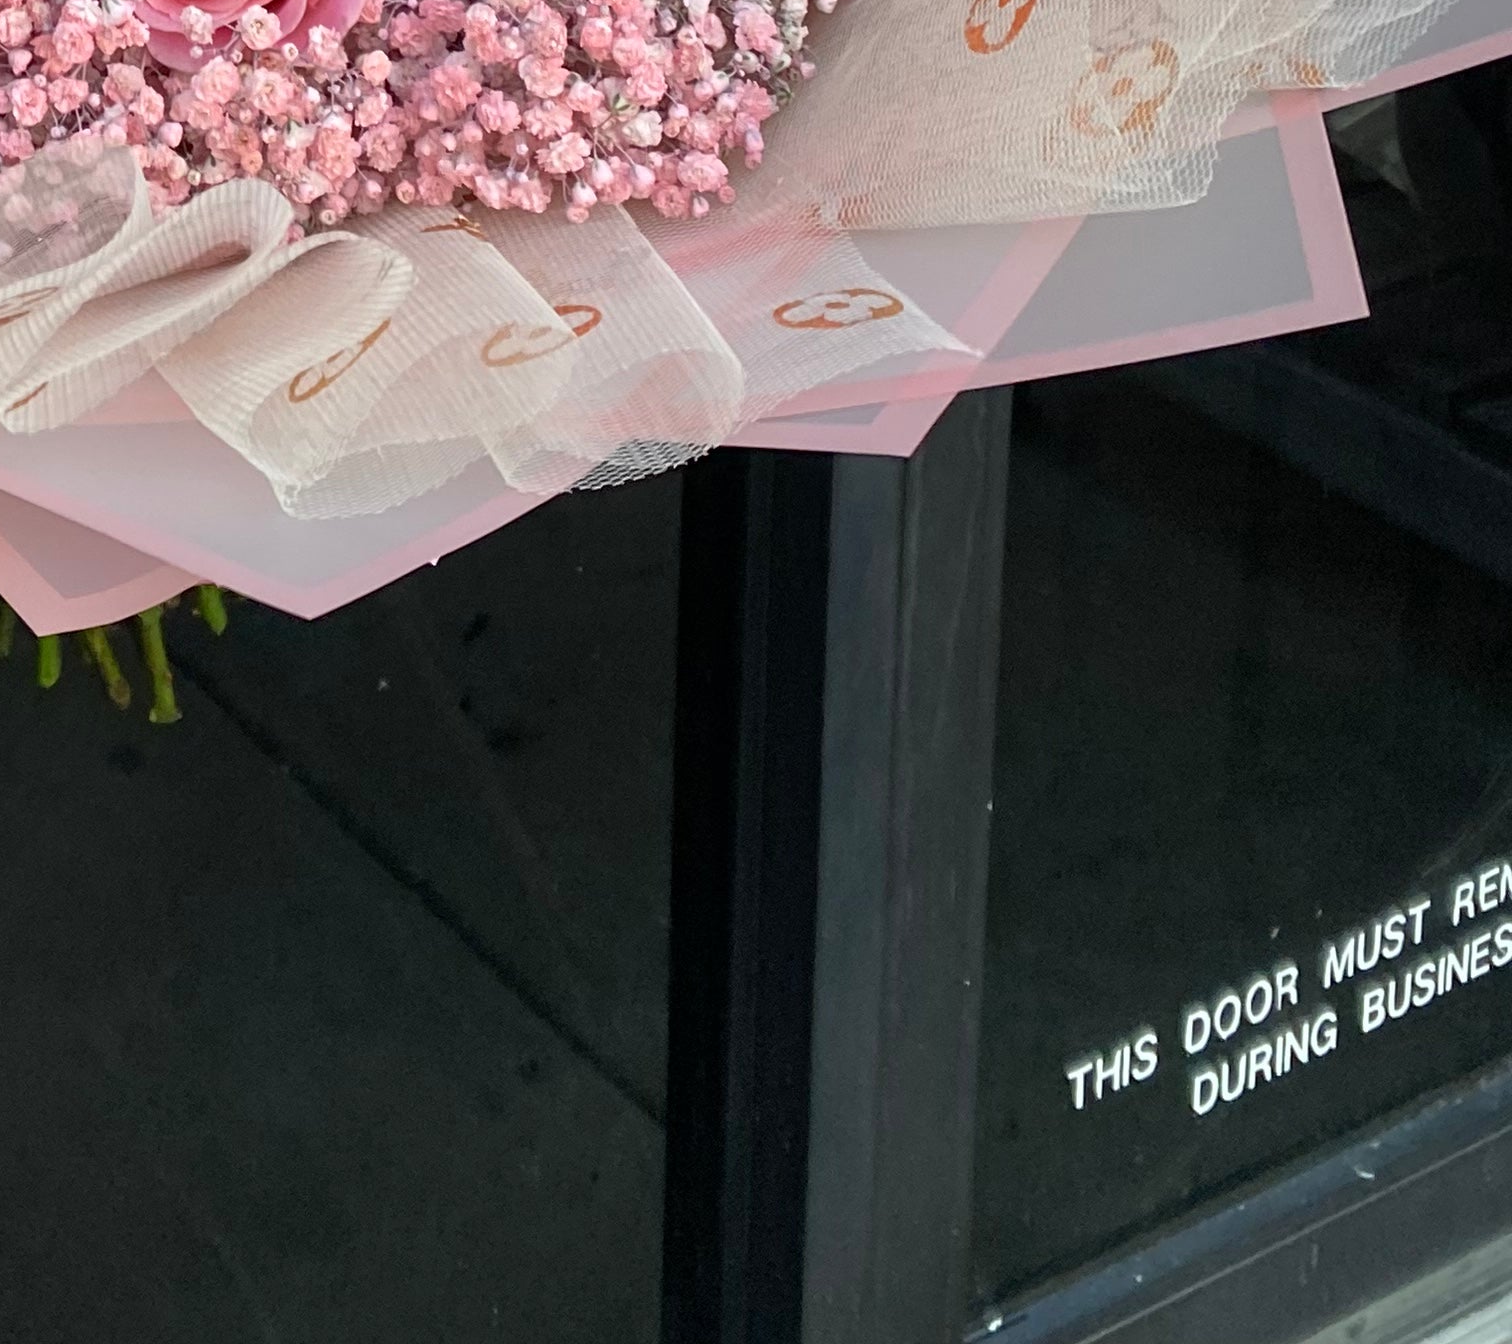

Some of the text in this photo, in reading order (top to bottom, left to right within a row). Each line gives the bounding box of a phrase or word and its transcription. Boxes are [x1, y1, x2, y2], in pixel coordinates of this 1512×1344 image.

[1067, 1033, 1158, 1110] THIS
[1184, 962, 1299, 1055] DOOR
[1322, 899, 1431, 989] MUST
[1192, 1010, 1338, 1116] DURING
